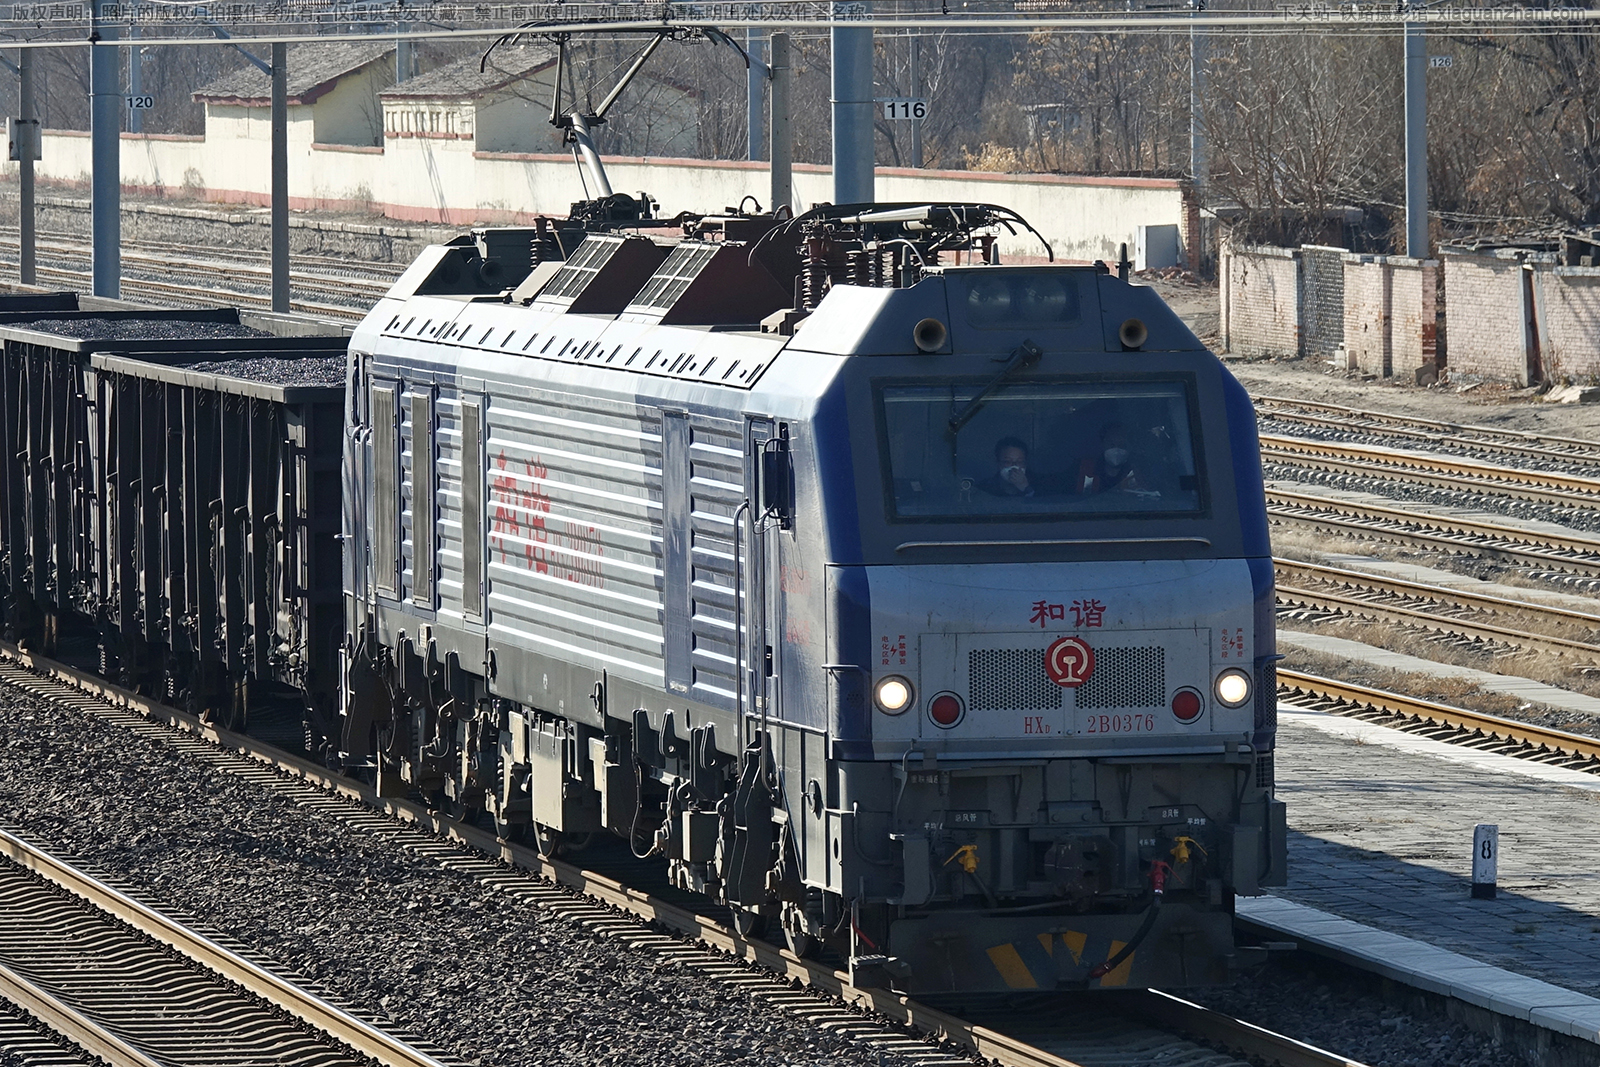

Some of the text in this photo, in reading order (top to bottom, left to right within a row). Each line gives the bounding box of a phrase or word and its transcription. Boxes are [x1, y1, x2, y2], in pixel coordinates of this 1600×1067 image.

[1432, 58, 1451, 67] 126
[127, 97, 153, 108] 120
[887, 102, 926, 118] 116
[1029, 599, 1107, 628] 和谐
[881, 636, 889, 666] 电化区段
[1024, 714, 1154, 734] HXD 2B0376
[923, 822, 944, 831] 平均
[1481, 840, 1492, 860] 8
